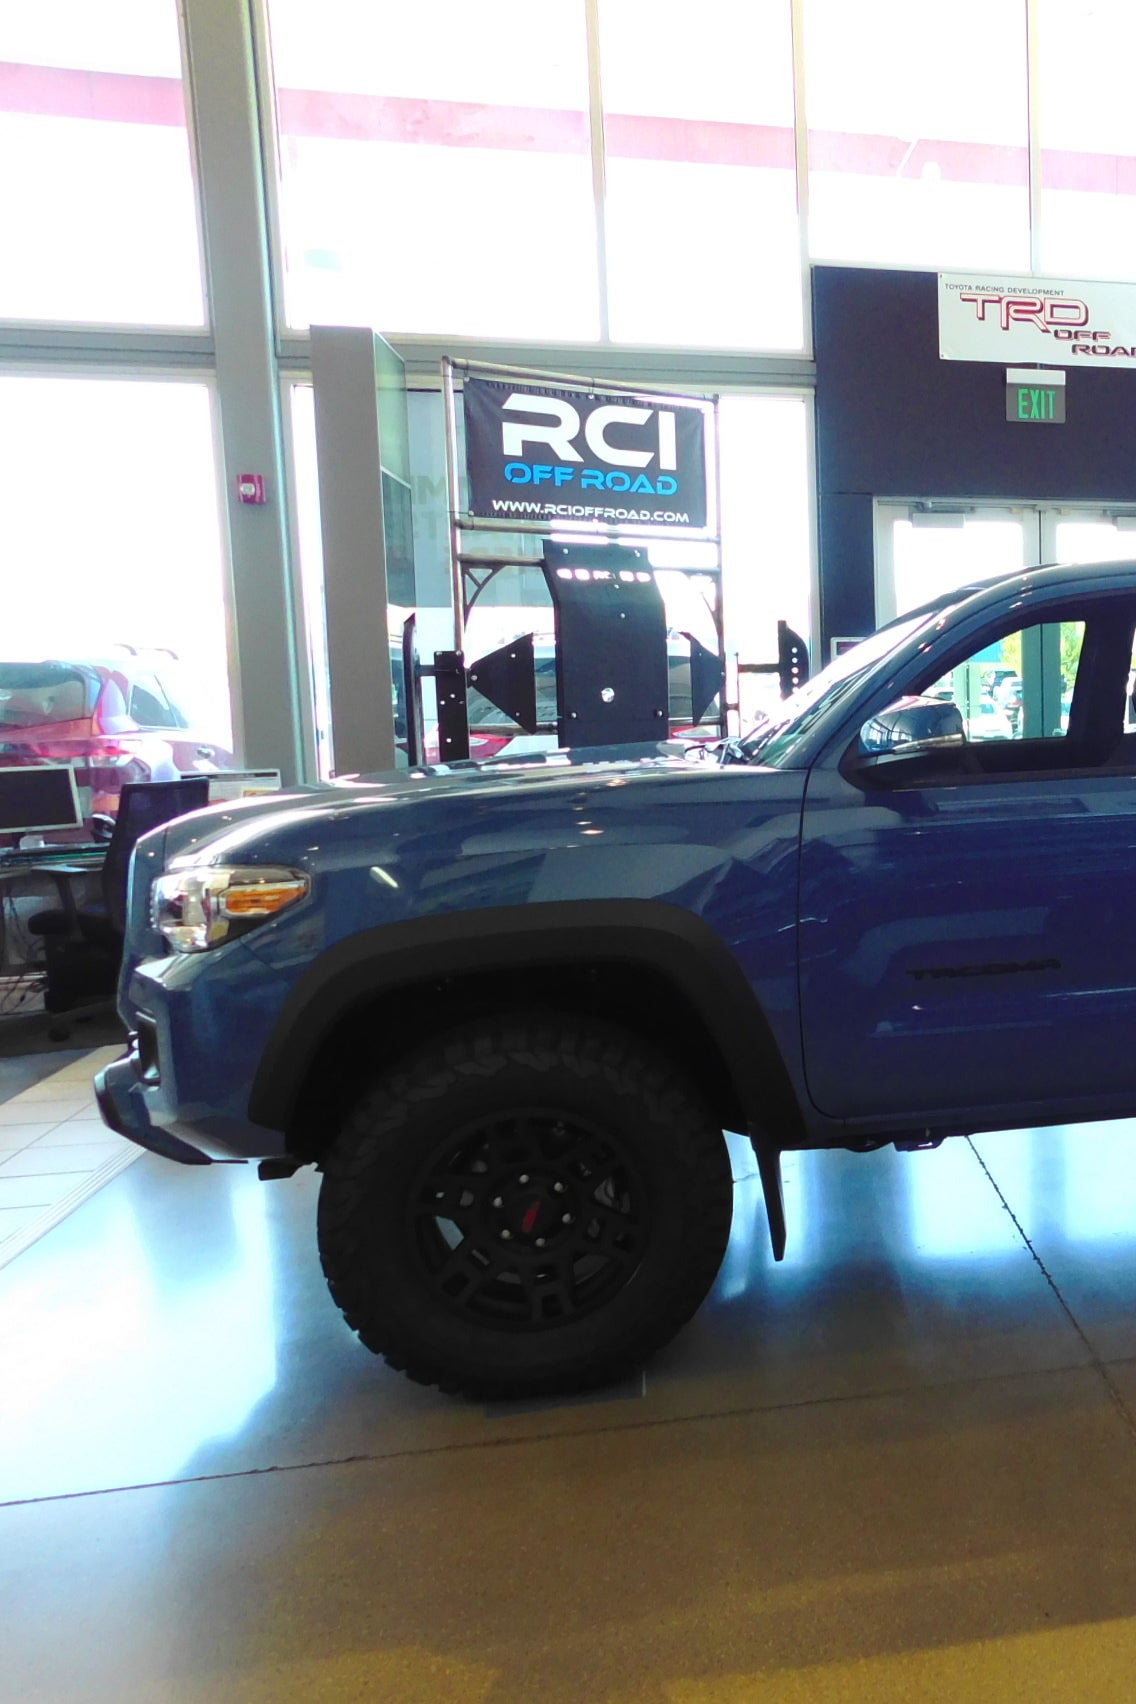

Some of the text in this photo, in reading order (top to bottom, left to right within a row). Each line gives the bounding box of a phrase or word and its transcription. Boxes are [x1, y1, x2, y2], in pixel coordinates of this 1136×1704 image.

[944, 283, 1065, 297] TOYOTA RACING DEVELOPMENT
[959, 292, 1089, 333] TRD
[1053, 328, 1112, 342] OFF
[1017, 388, 1056, 420] EXIT
[501, 392, 678, 471] RCI
[503, 461, 679, 496] OFF ROAD
[491, 498, 690, 524] WWW.RCIOFFROAD.COM
